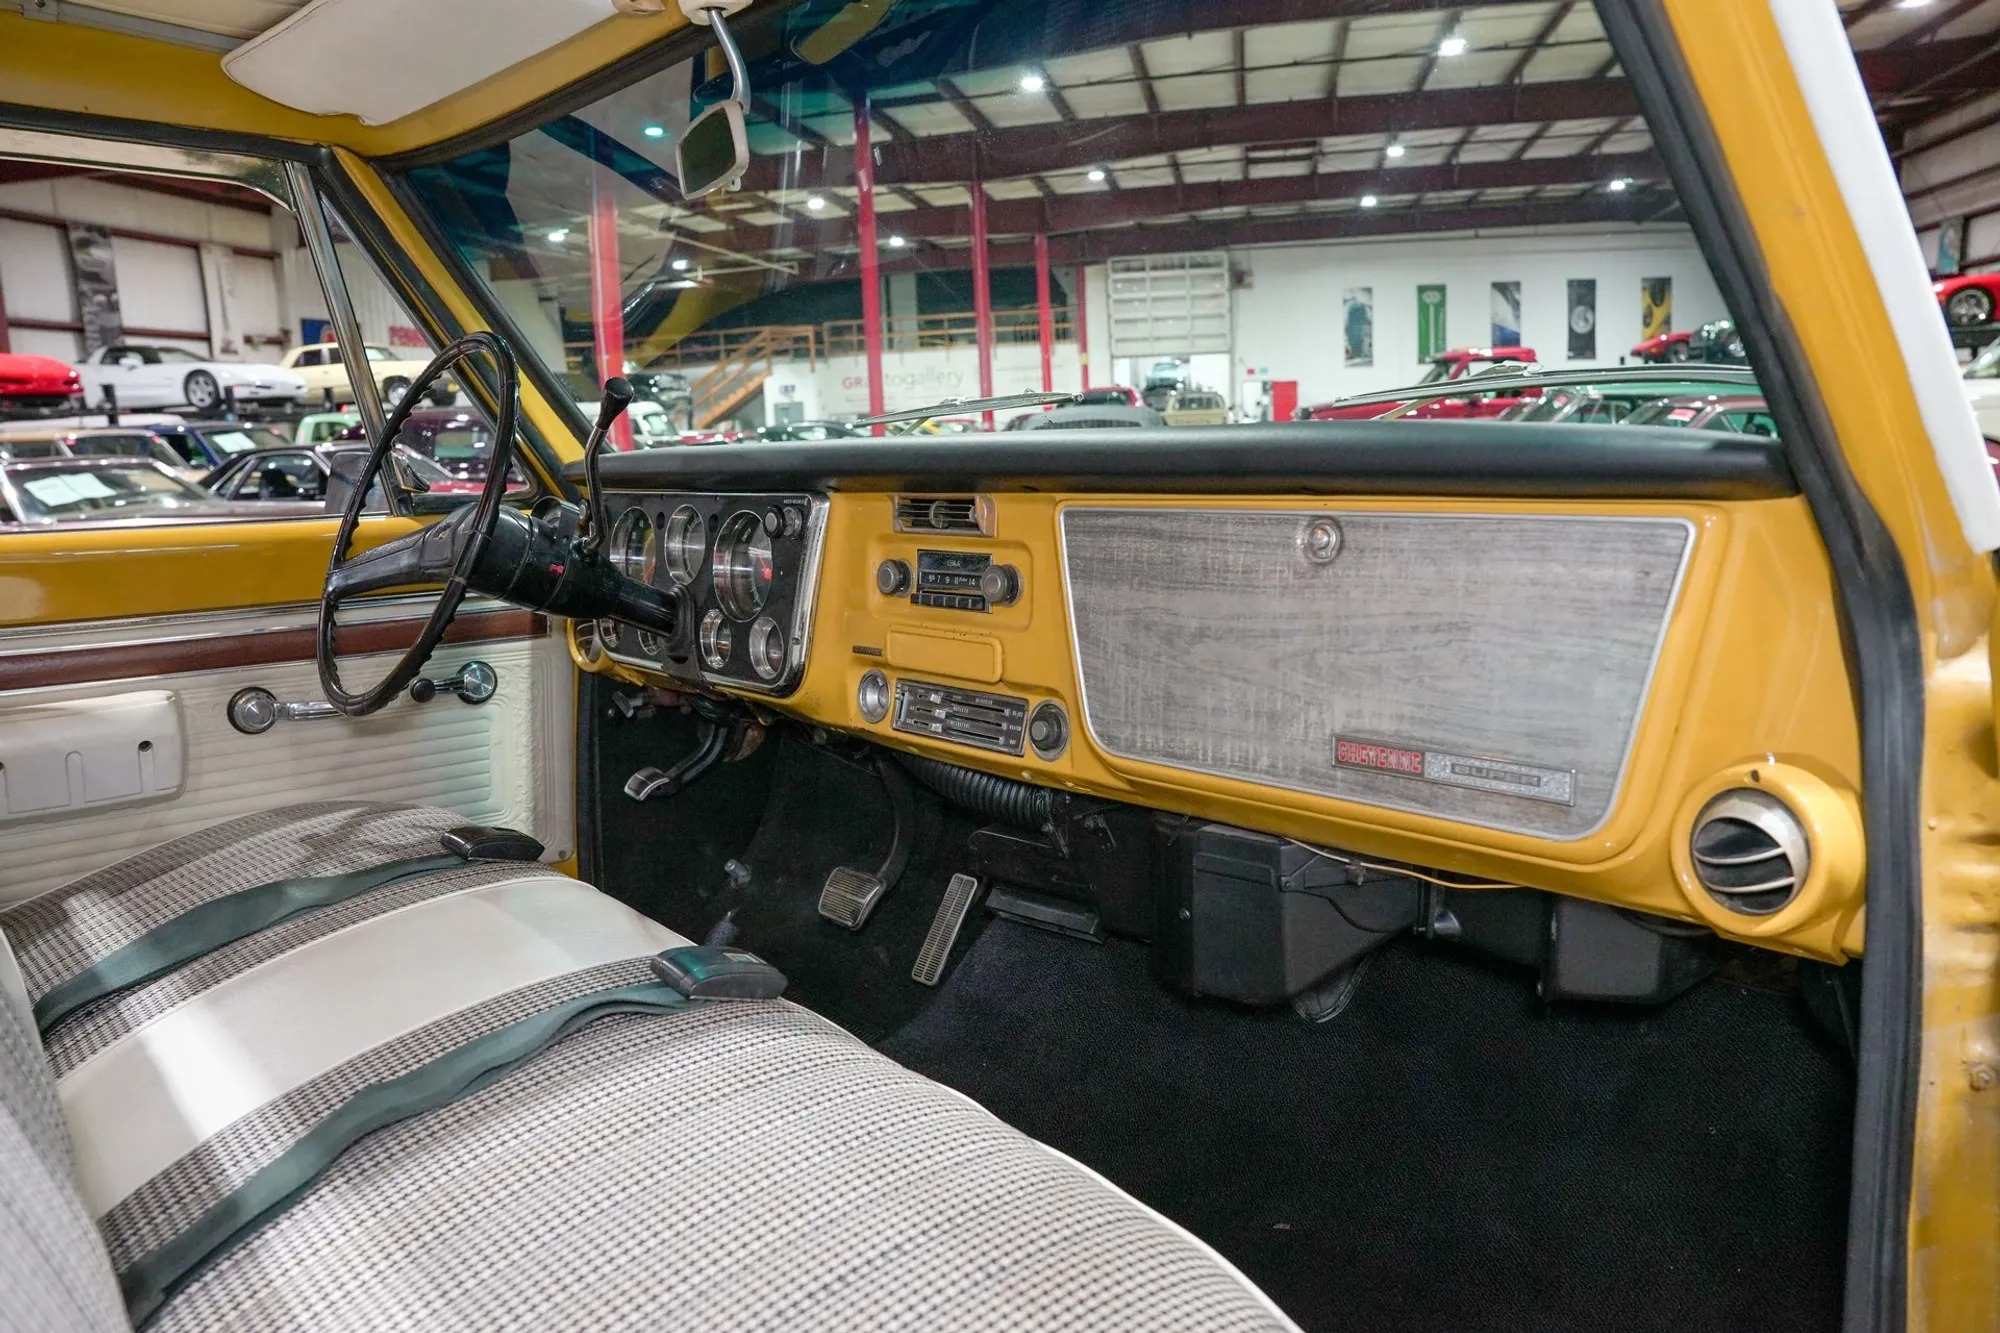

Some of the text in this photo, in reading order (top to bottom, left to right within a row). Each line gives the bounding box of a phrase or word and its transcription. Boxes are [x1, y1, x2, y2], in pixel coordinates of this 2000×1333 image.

[842, 366, 964, 390] GRtogallery
[944, 576, 950, 584] 9
[1338, 742, 1540, 787] CHEYENNE SUPER
